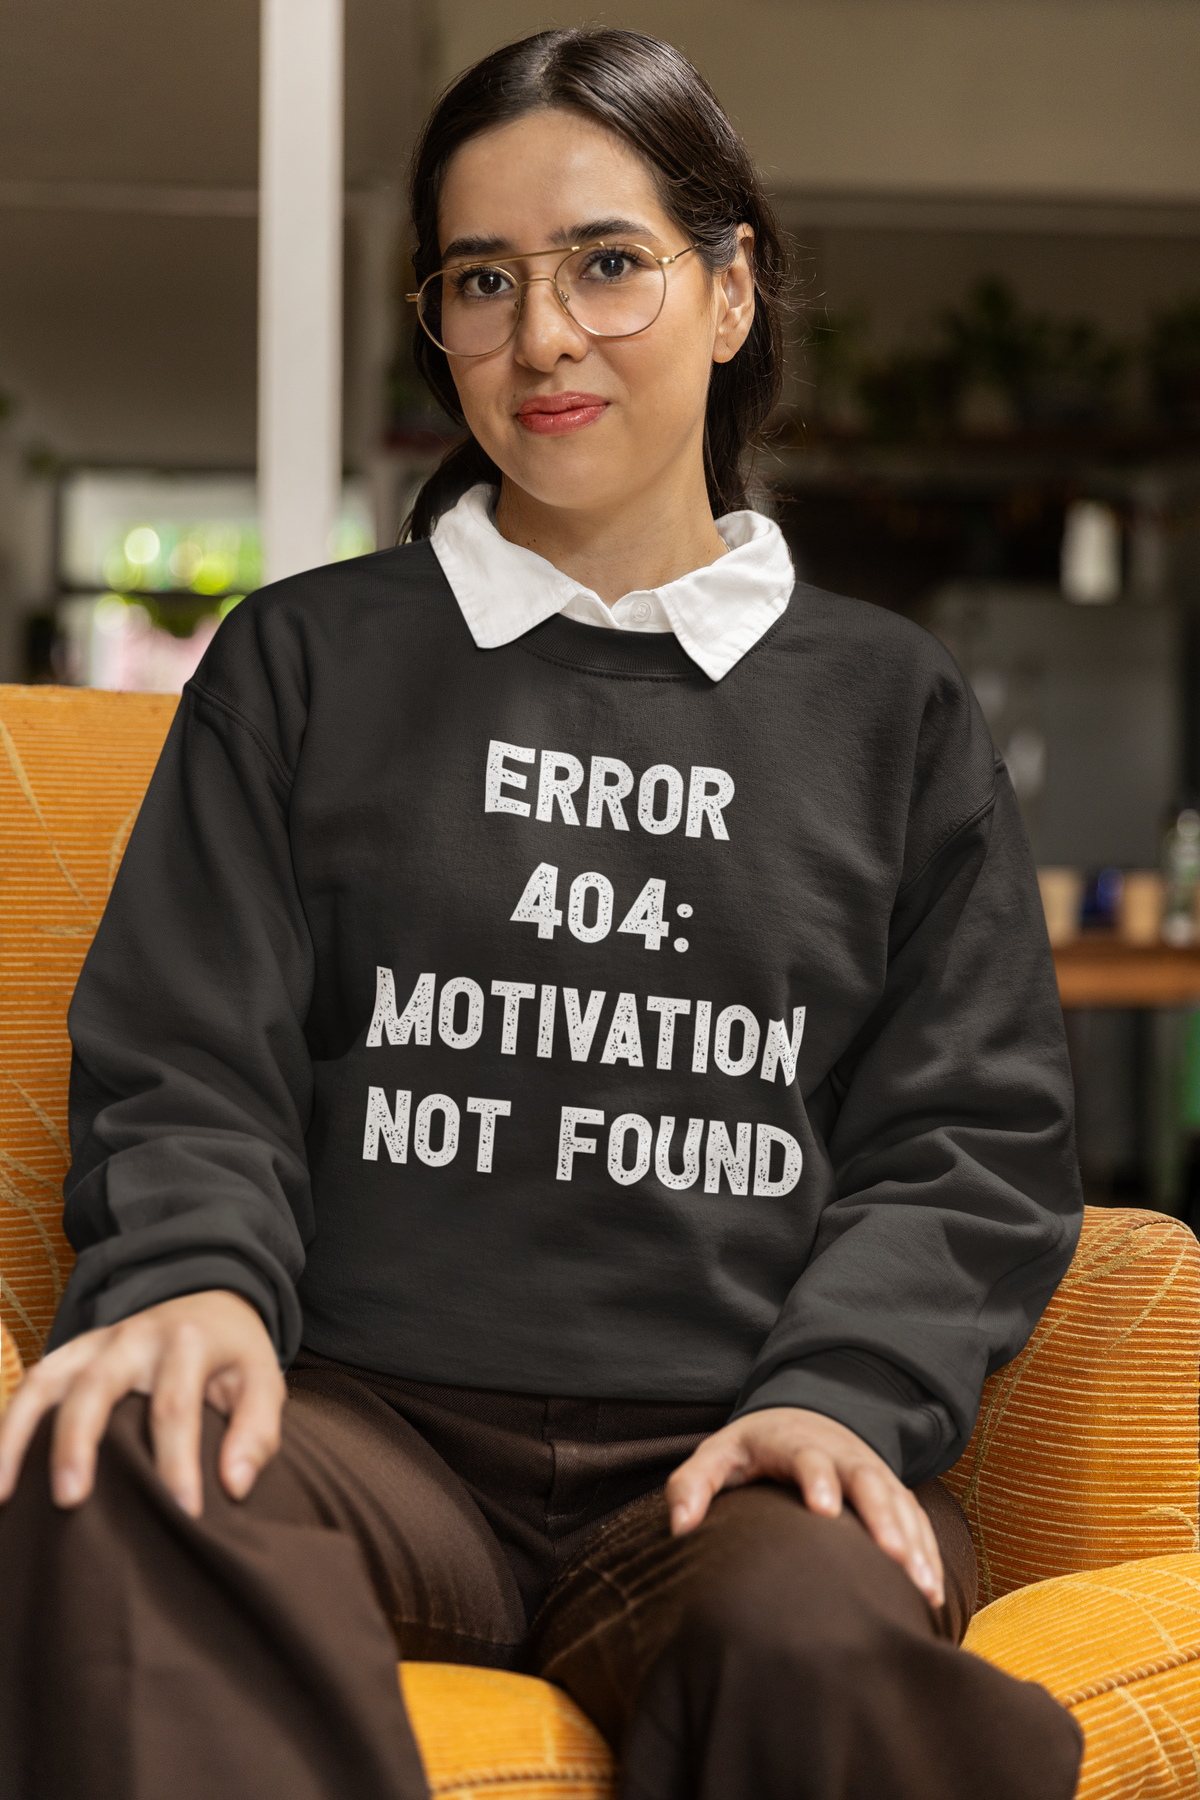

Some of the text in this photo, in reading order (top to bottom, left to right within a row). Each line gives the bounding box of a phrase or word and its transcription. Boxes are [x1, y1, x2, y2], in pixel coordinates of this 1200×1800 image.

[485, 740, 735, 840] ERROR
[510, 862, 693, 952] 404:
[366, 966, 805, 1086] MOTIVATION
[363, 1087, 802, 1196] NOT FOUND
